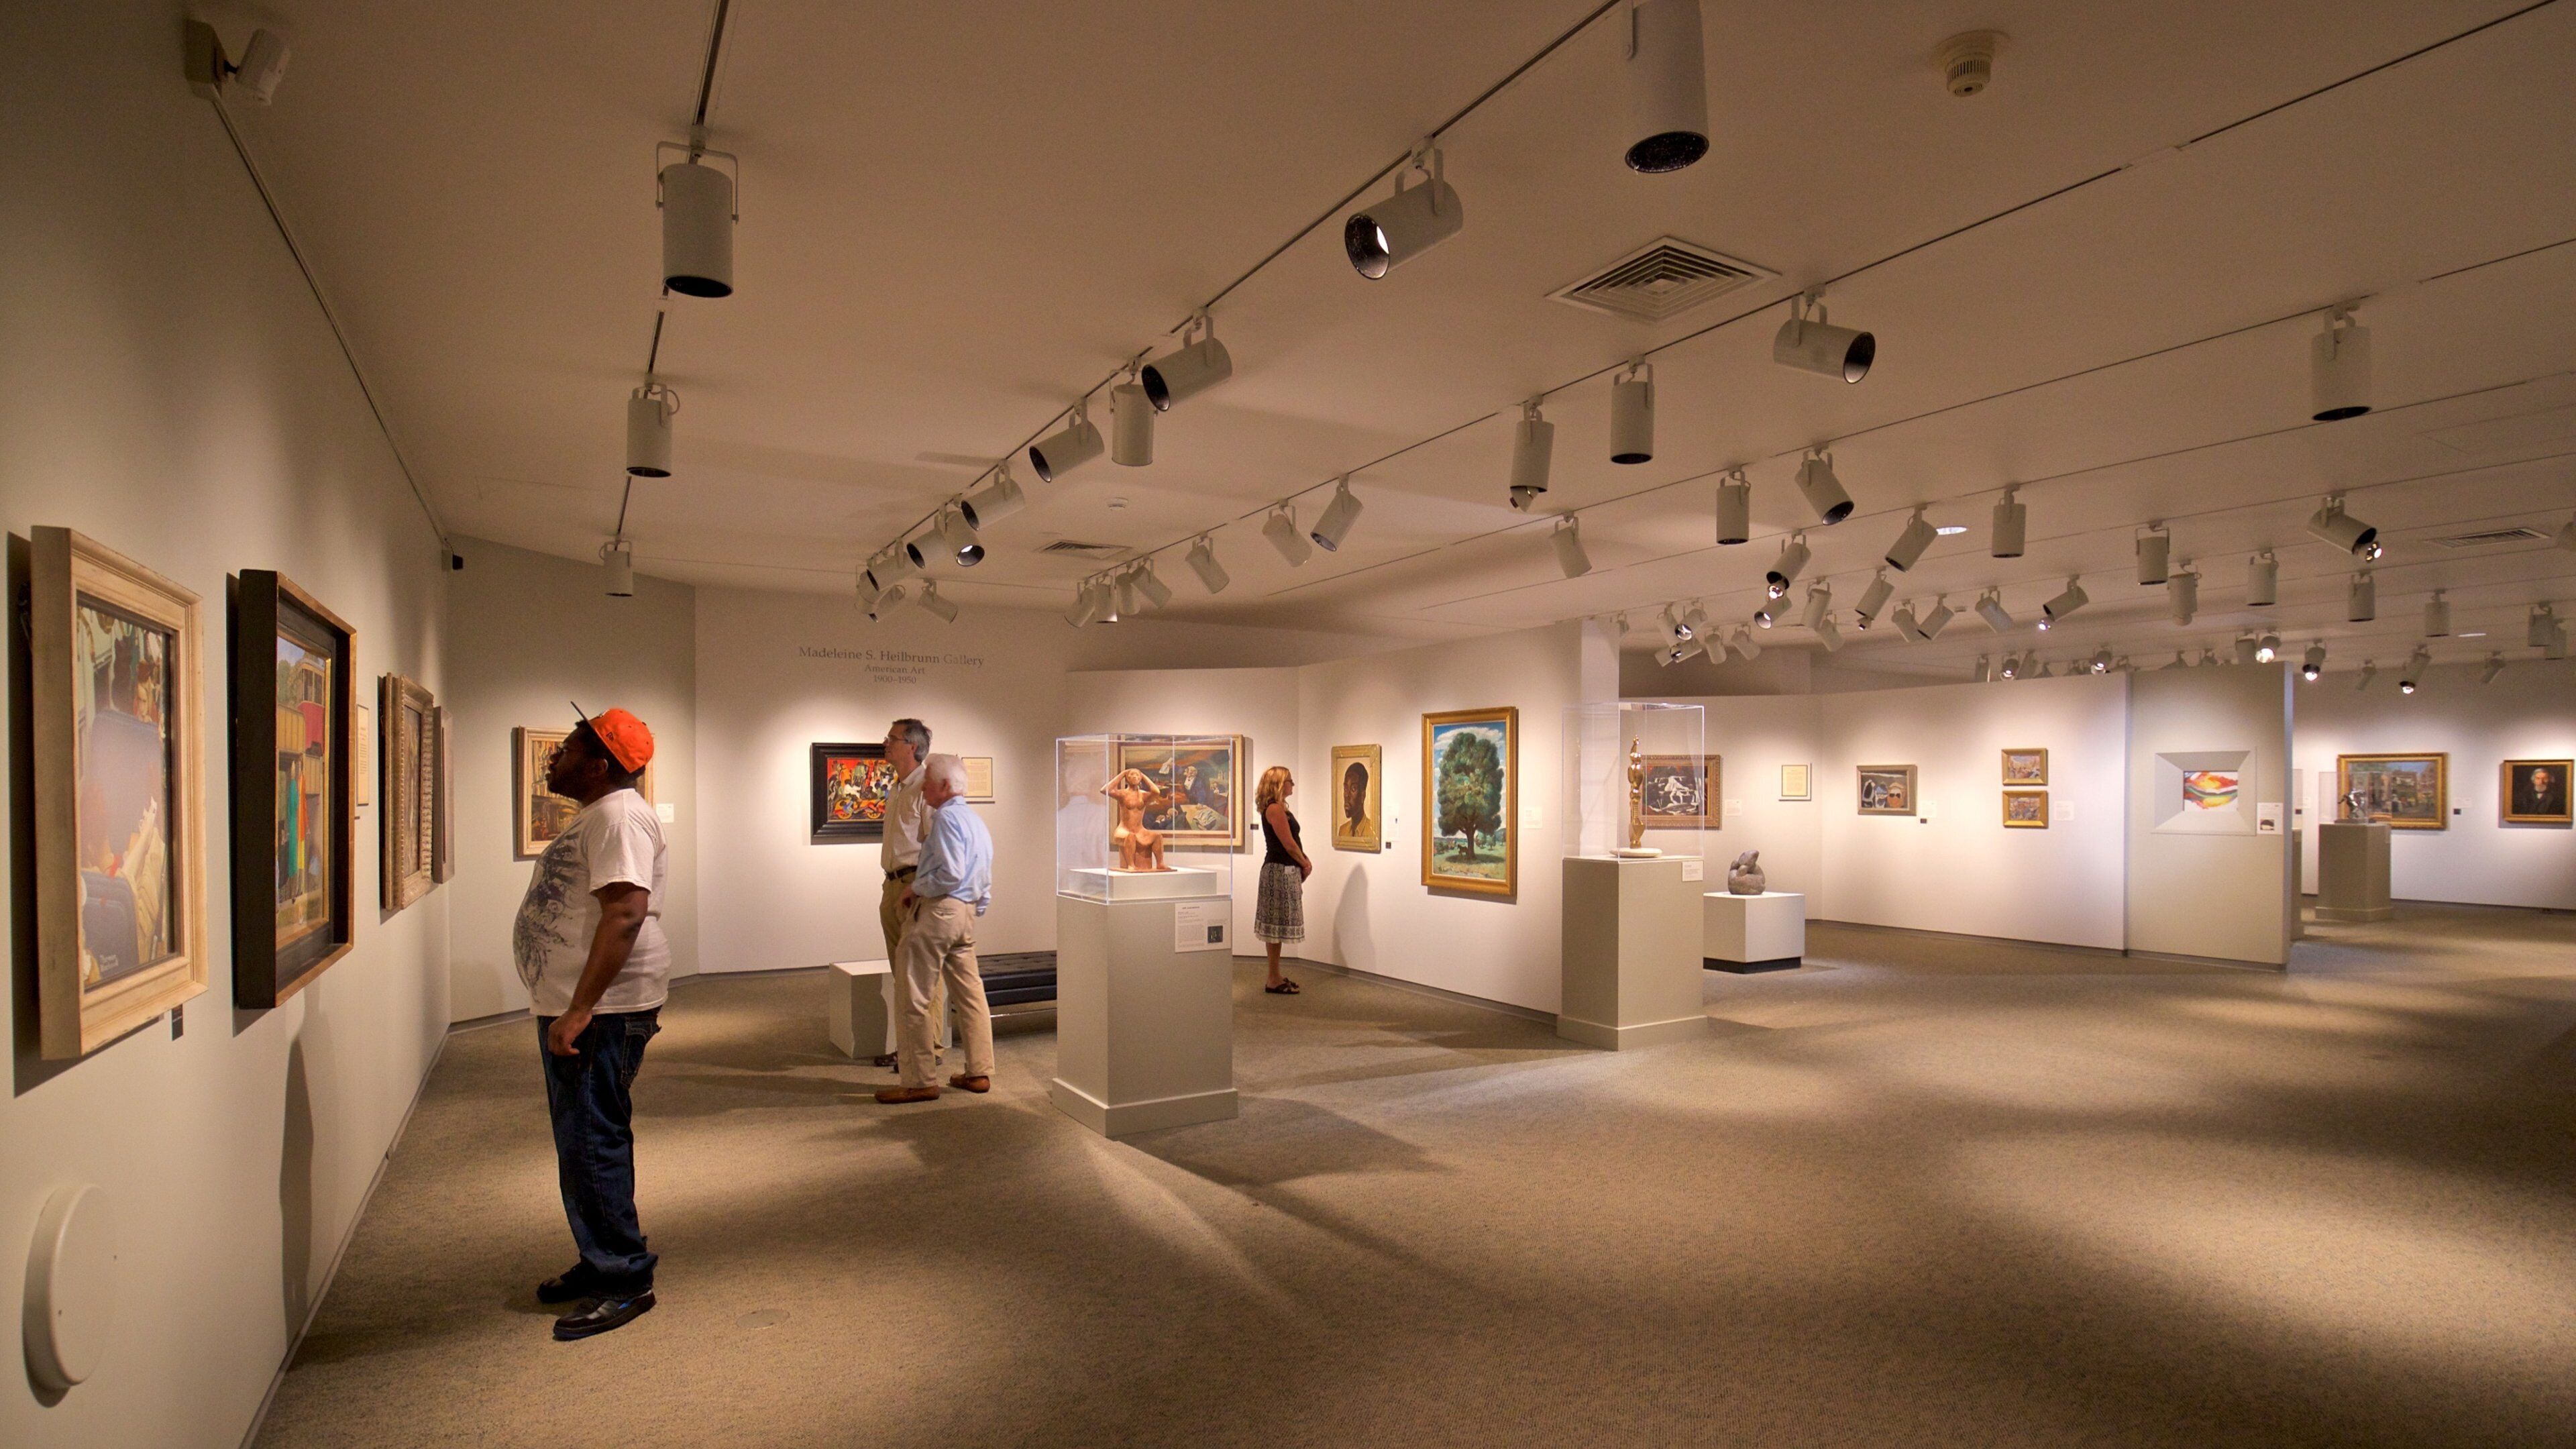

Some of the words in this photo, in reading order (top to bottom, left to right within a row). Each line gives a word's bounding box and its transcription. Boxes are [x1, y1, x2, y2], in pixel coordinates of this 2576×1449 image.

[798, 646, 863, 660] Madeleine
[865, 649, 876, 661] S.
[880, 650, 940, 664] Heilbrunn
[943, 653, 985, 669] Gallery
[864, 664, 908, 674] American
[910, 665, 925, 674] Art
